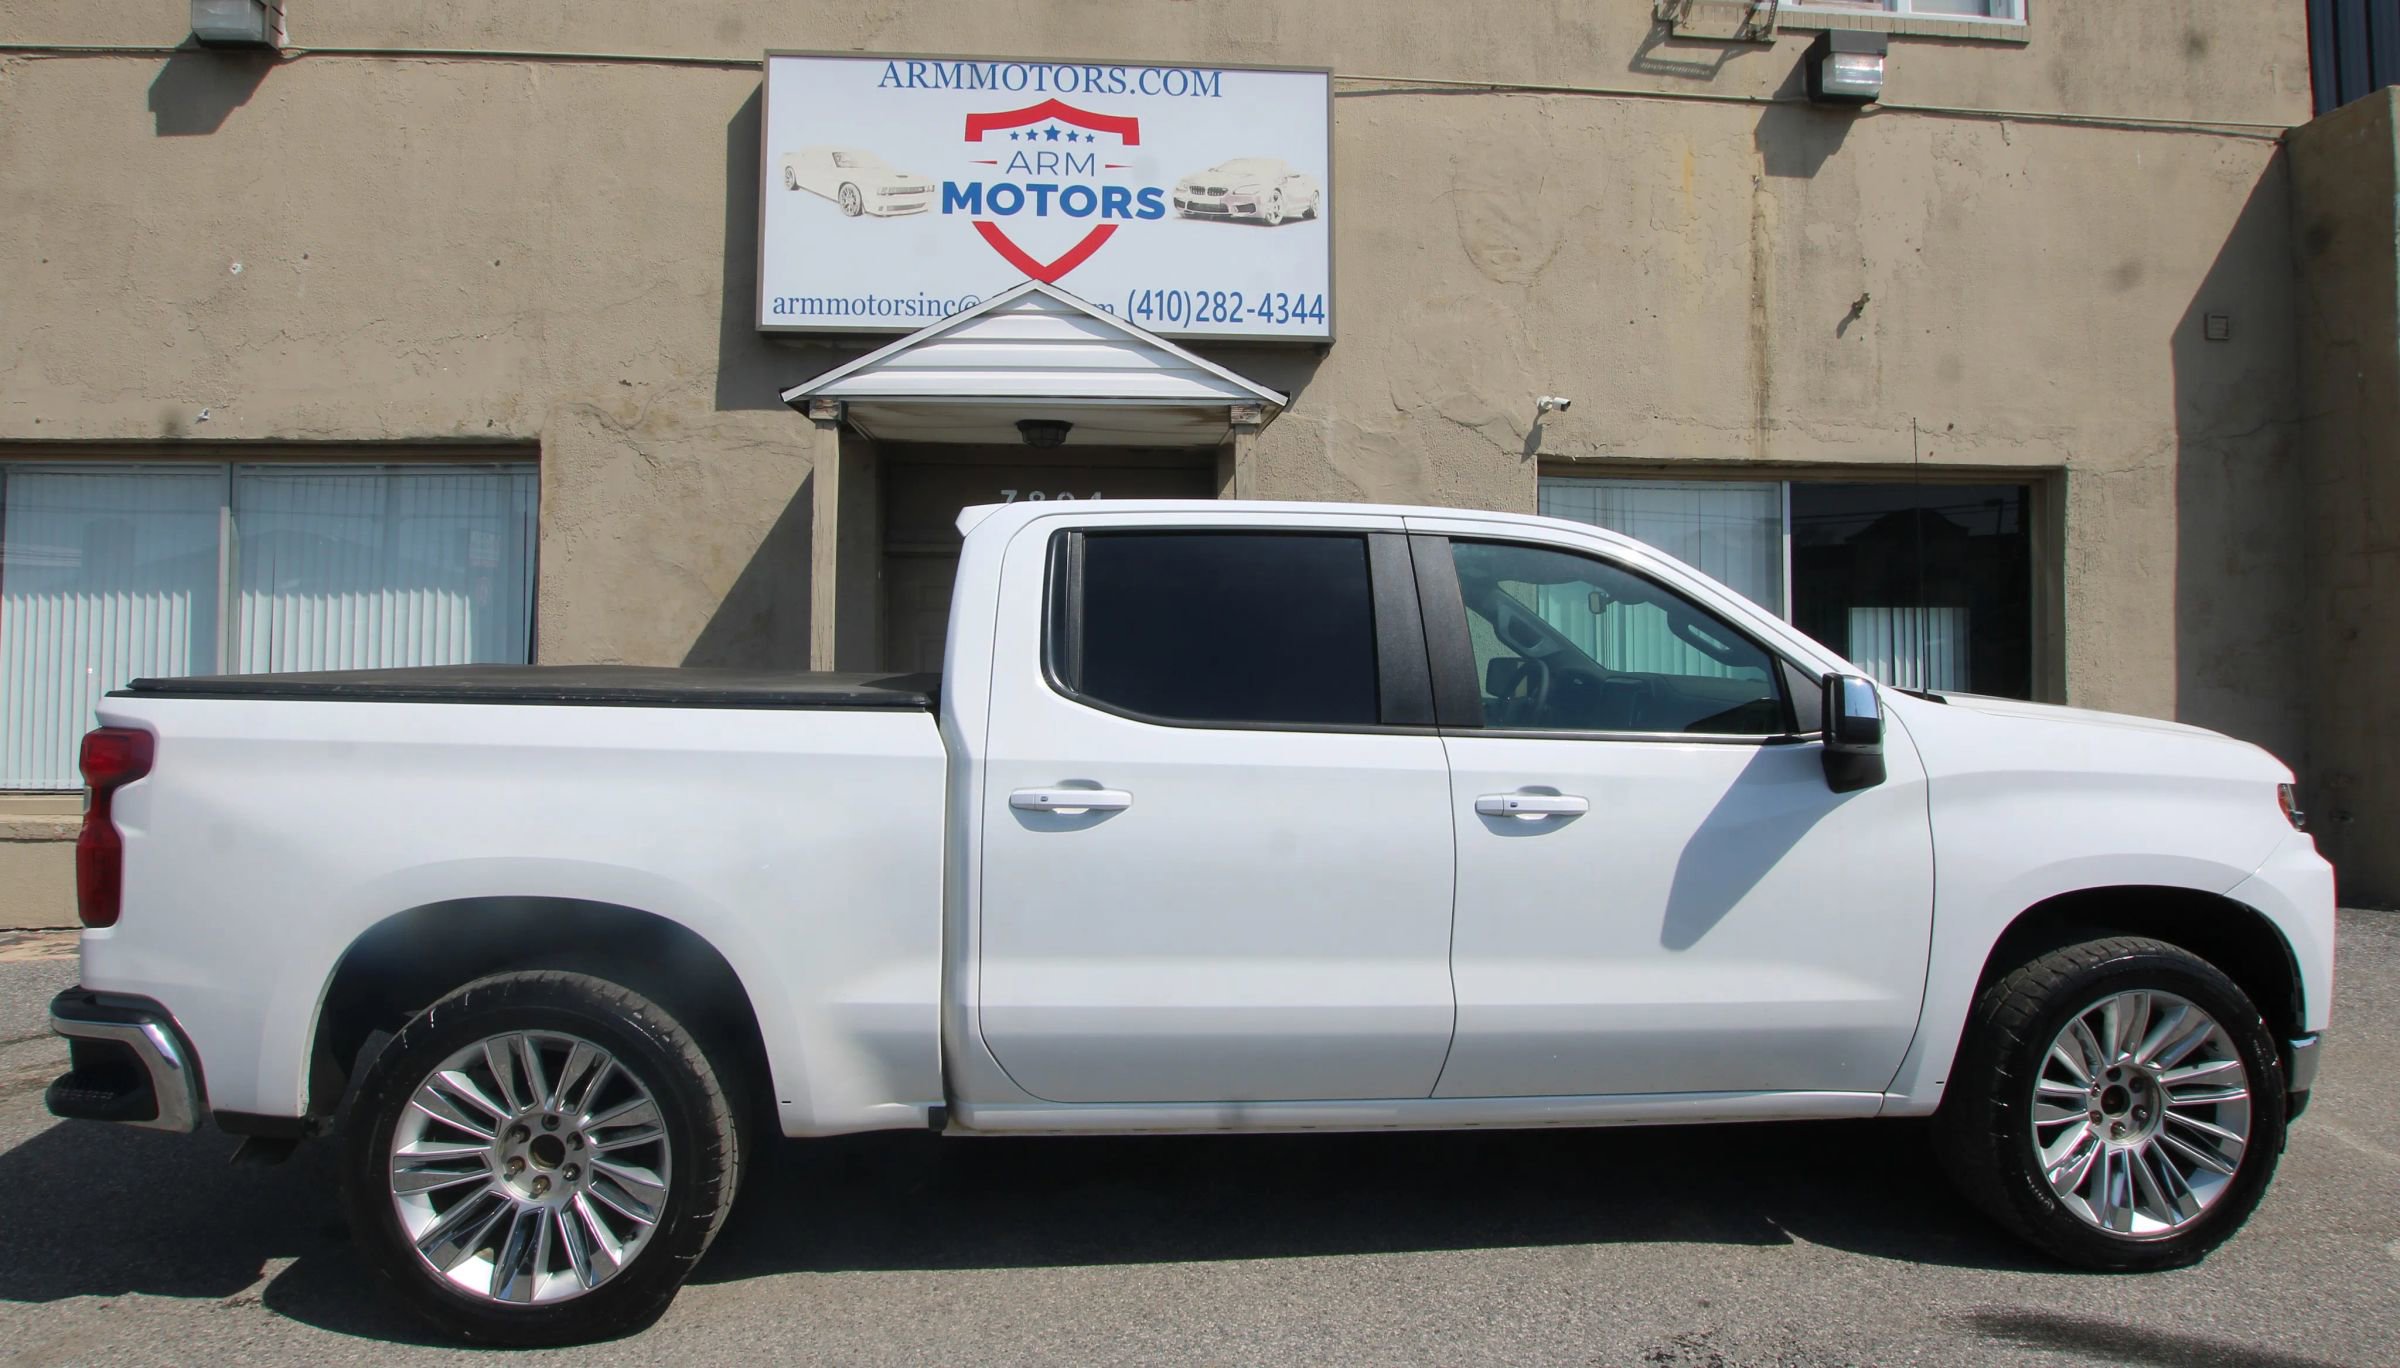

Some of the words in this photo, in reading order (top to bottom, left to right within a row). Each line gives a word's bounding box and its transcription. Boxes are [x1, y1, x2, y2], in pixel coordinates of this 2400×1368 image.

[877, 60, 1223, 98] ARMMOTORS.COM
[1005, 150, 1095, 177] ARM
[942, 181, 1166, 220] MOTORS
[1127, 289, 1326, 328] (410)282-4344
